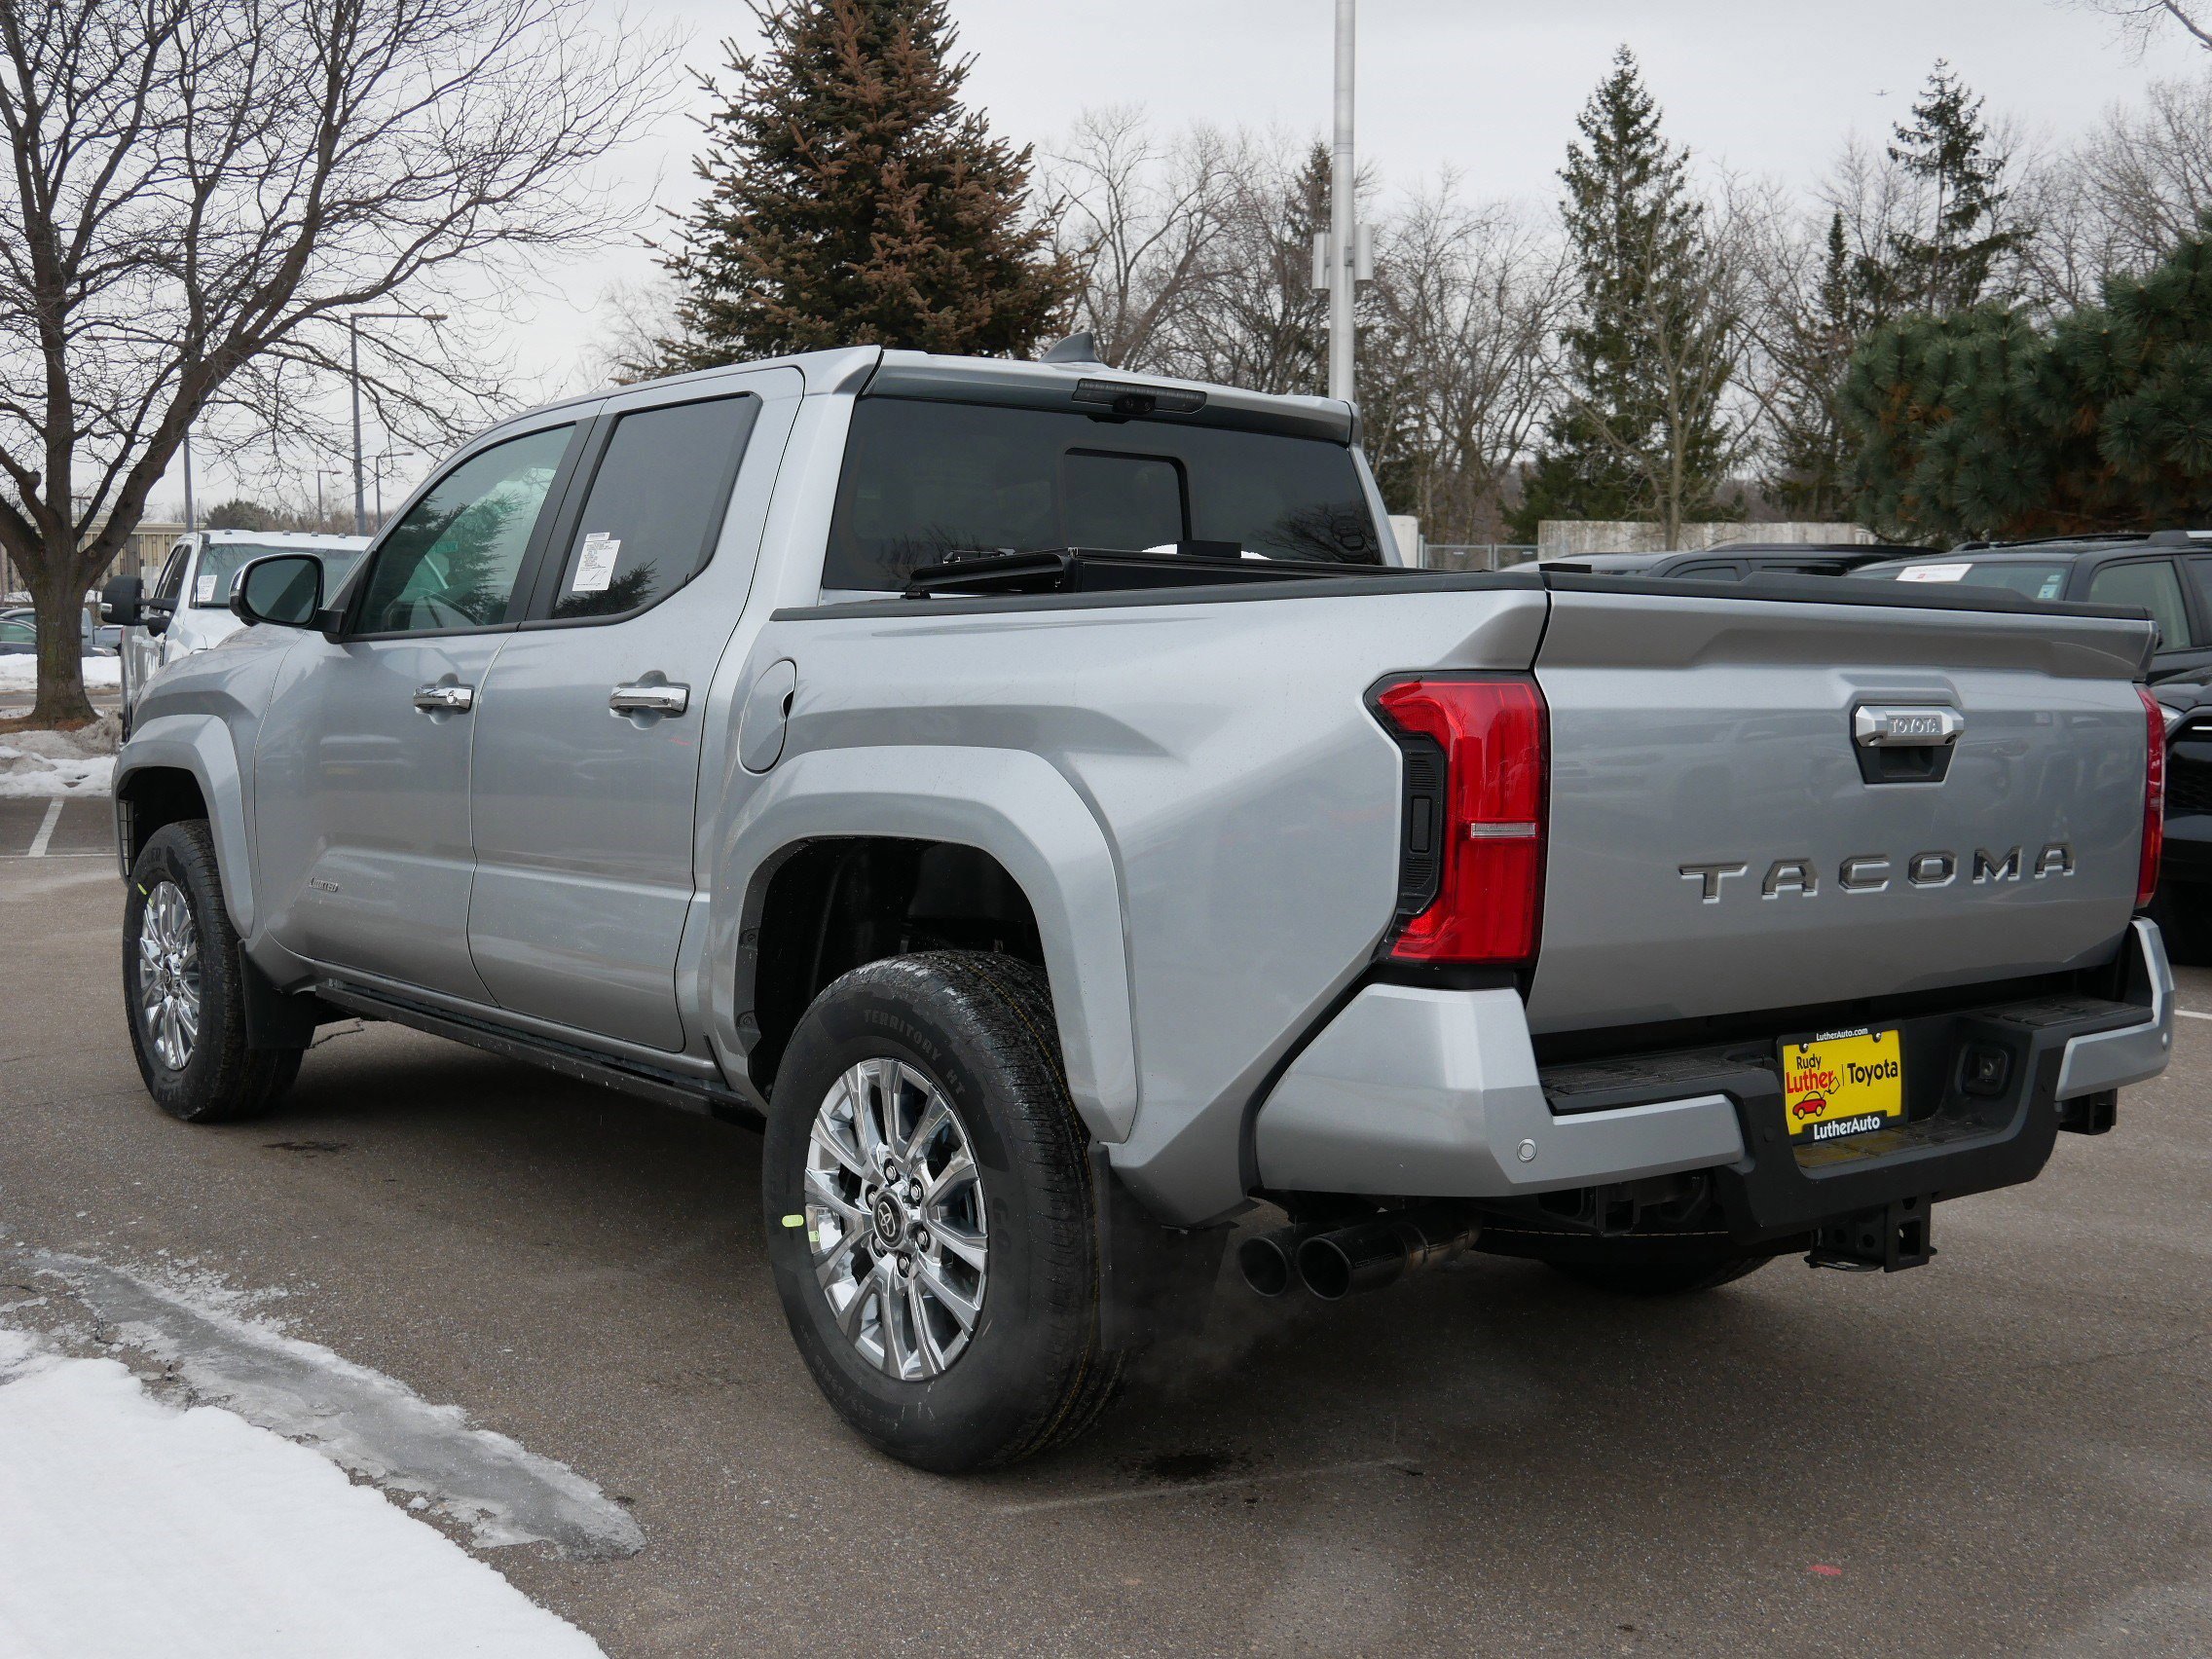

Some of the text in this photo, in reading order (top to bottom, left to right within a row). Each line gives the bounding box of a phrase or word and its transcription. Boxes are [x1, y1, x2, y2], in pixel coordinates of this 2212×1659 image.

[1890, 718, 1940, 733] TOYOTA
[1678, 842, 2077, 904] TACOMA
[1816, 1027, 1868, 1042] LutherAuto.com
[864, 1009, 966, 1095] TERRITORY HT
[1795, 1053, 1822, 1071] Rudy
[1786, 1068, 1834, 1094] Luther
[1847, 1058, 1899, 1088] Toyota
[1814, 1115, 1881, 1140] LutherAuto
